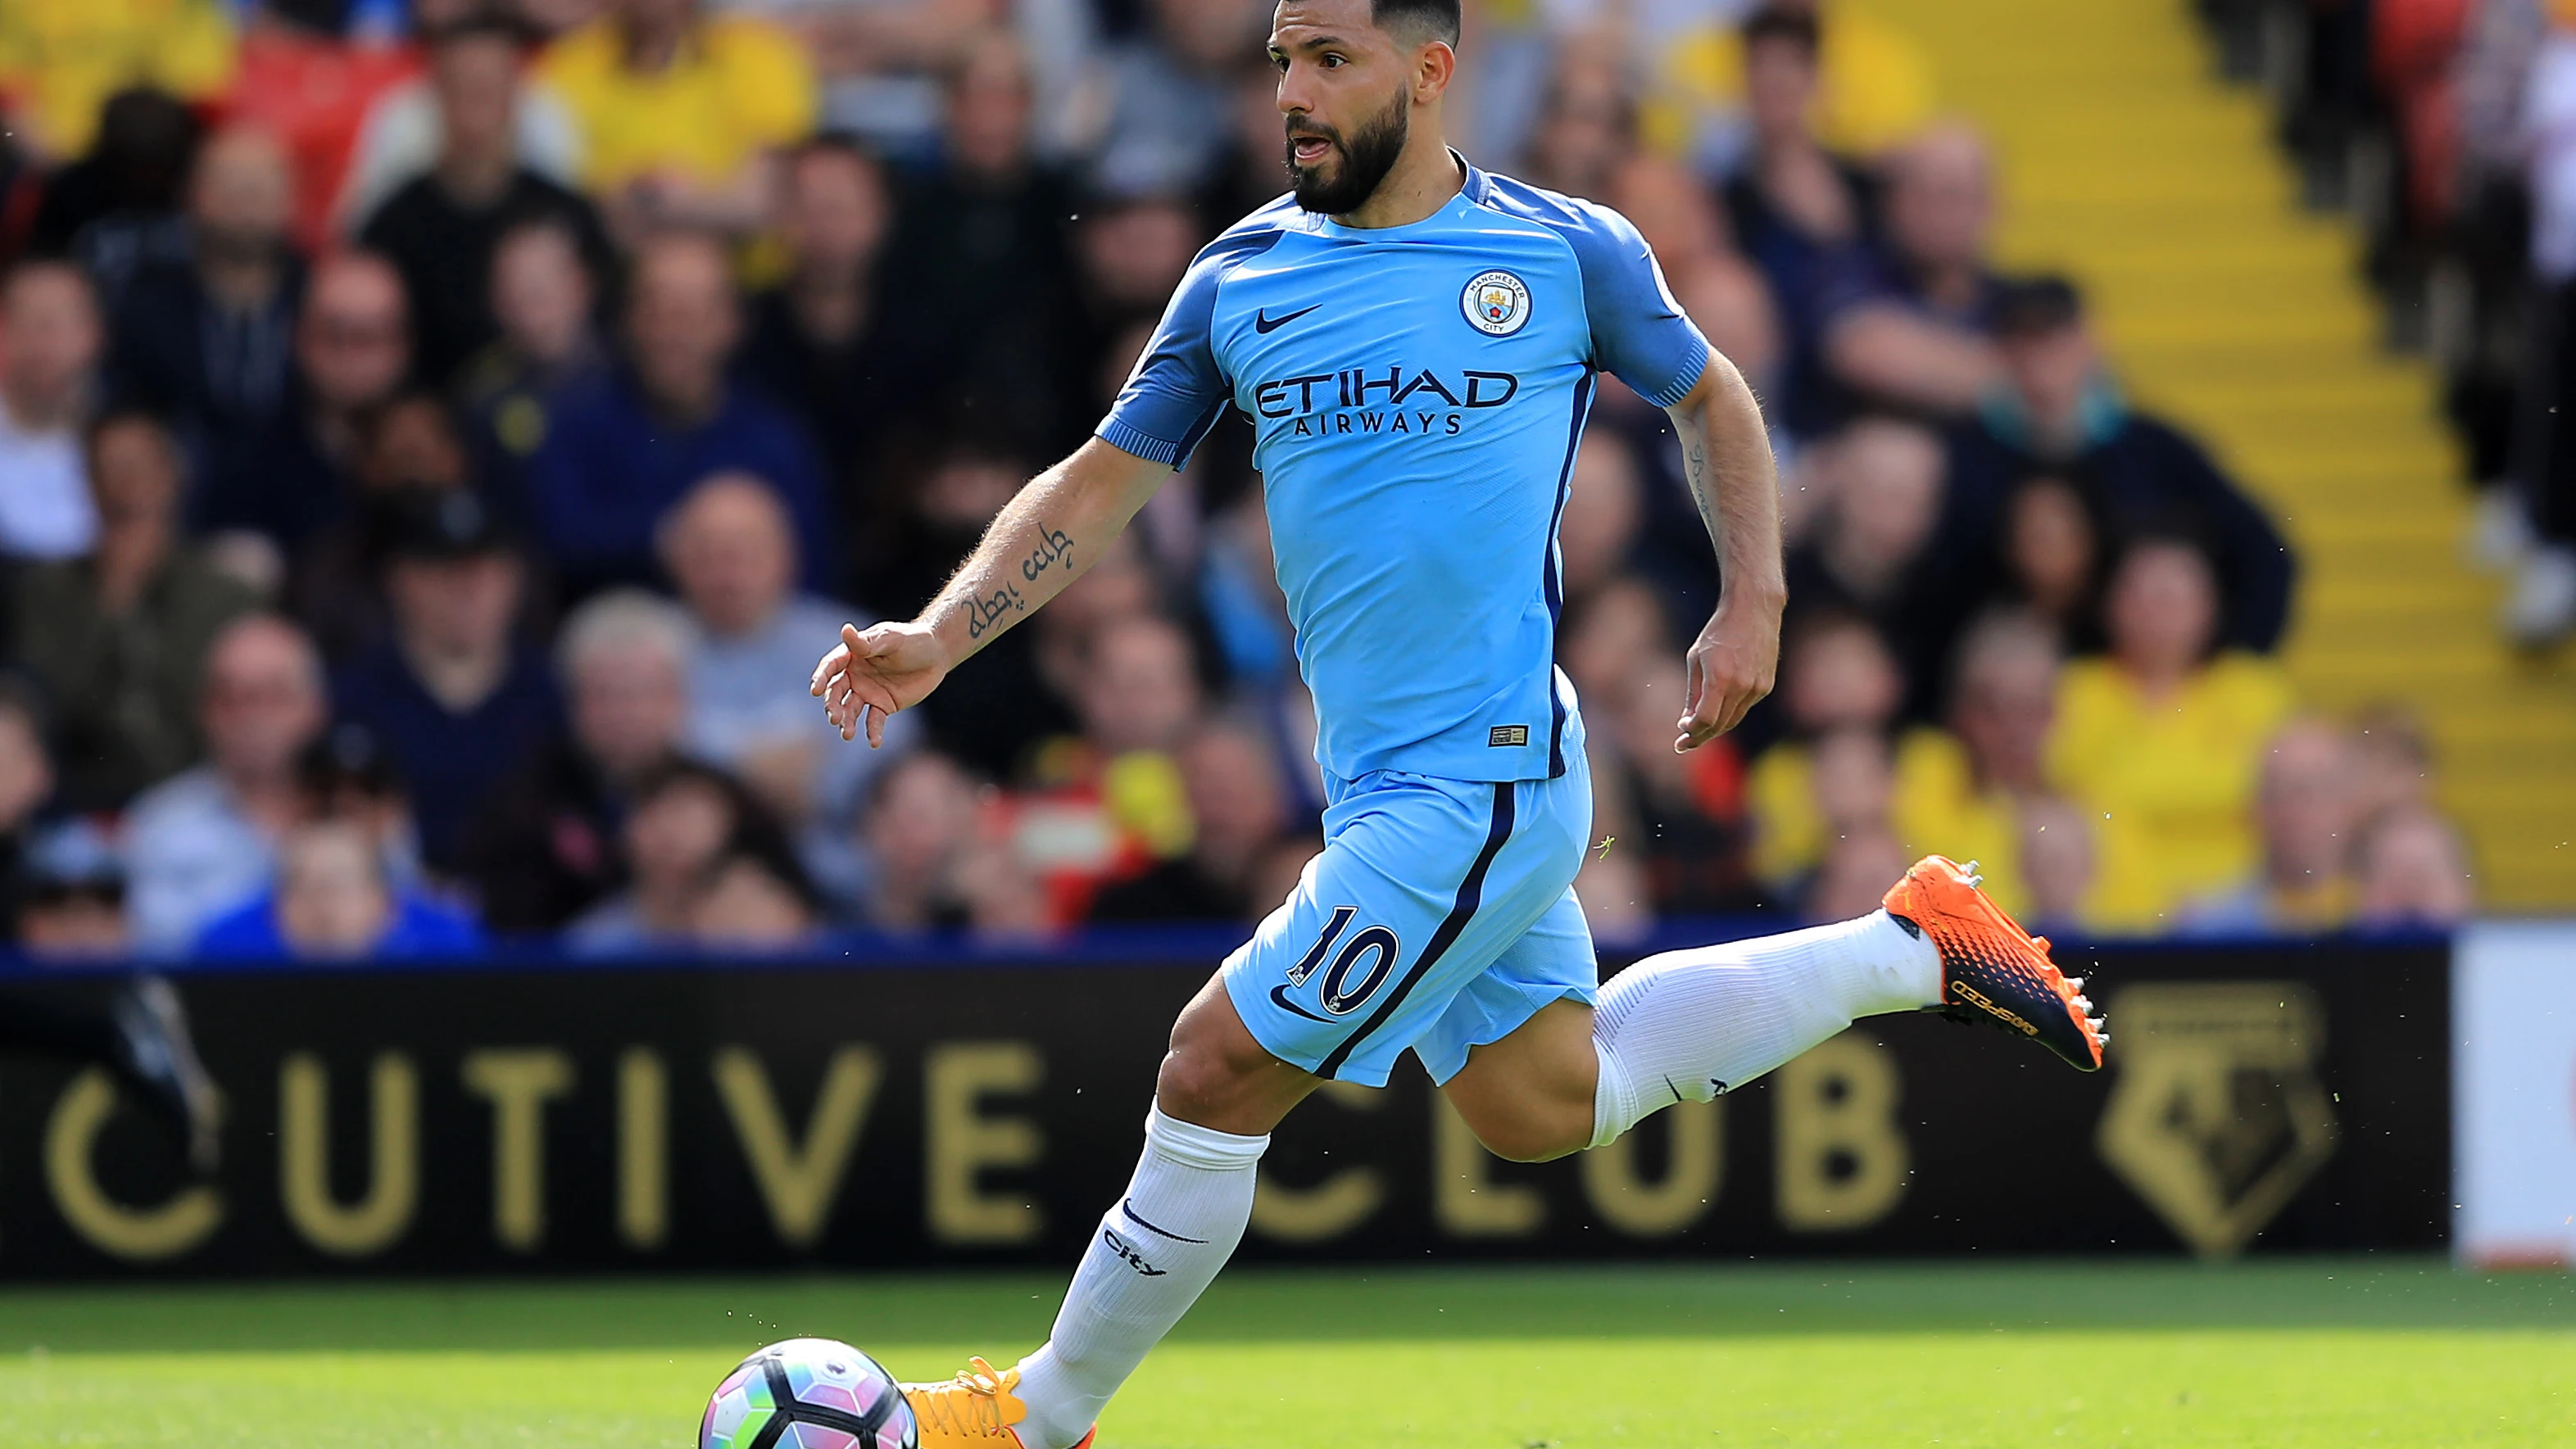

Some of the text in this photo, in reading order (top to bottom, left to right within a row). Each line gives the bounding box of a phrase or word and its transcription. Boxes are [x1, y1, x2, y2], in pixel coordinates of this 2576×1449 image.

[1470, 274, 1525, 299] MANCHESTER
[1483, 324, 1504, 333] CITY
[1255, 366, 1518, 419] ETIHAD
[1295, 411, 1462, 436] AIRWAYS
[1286, 906, 1400, 1016] 10
